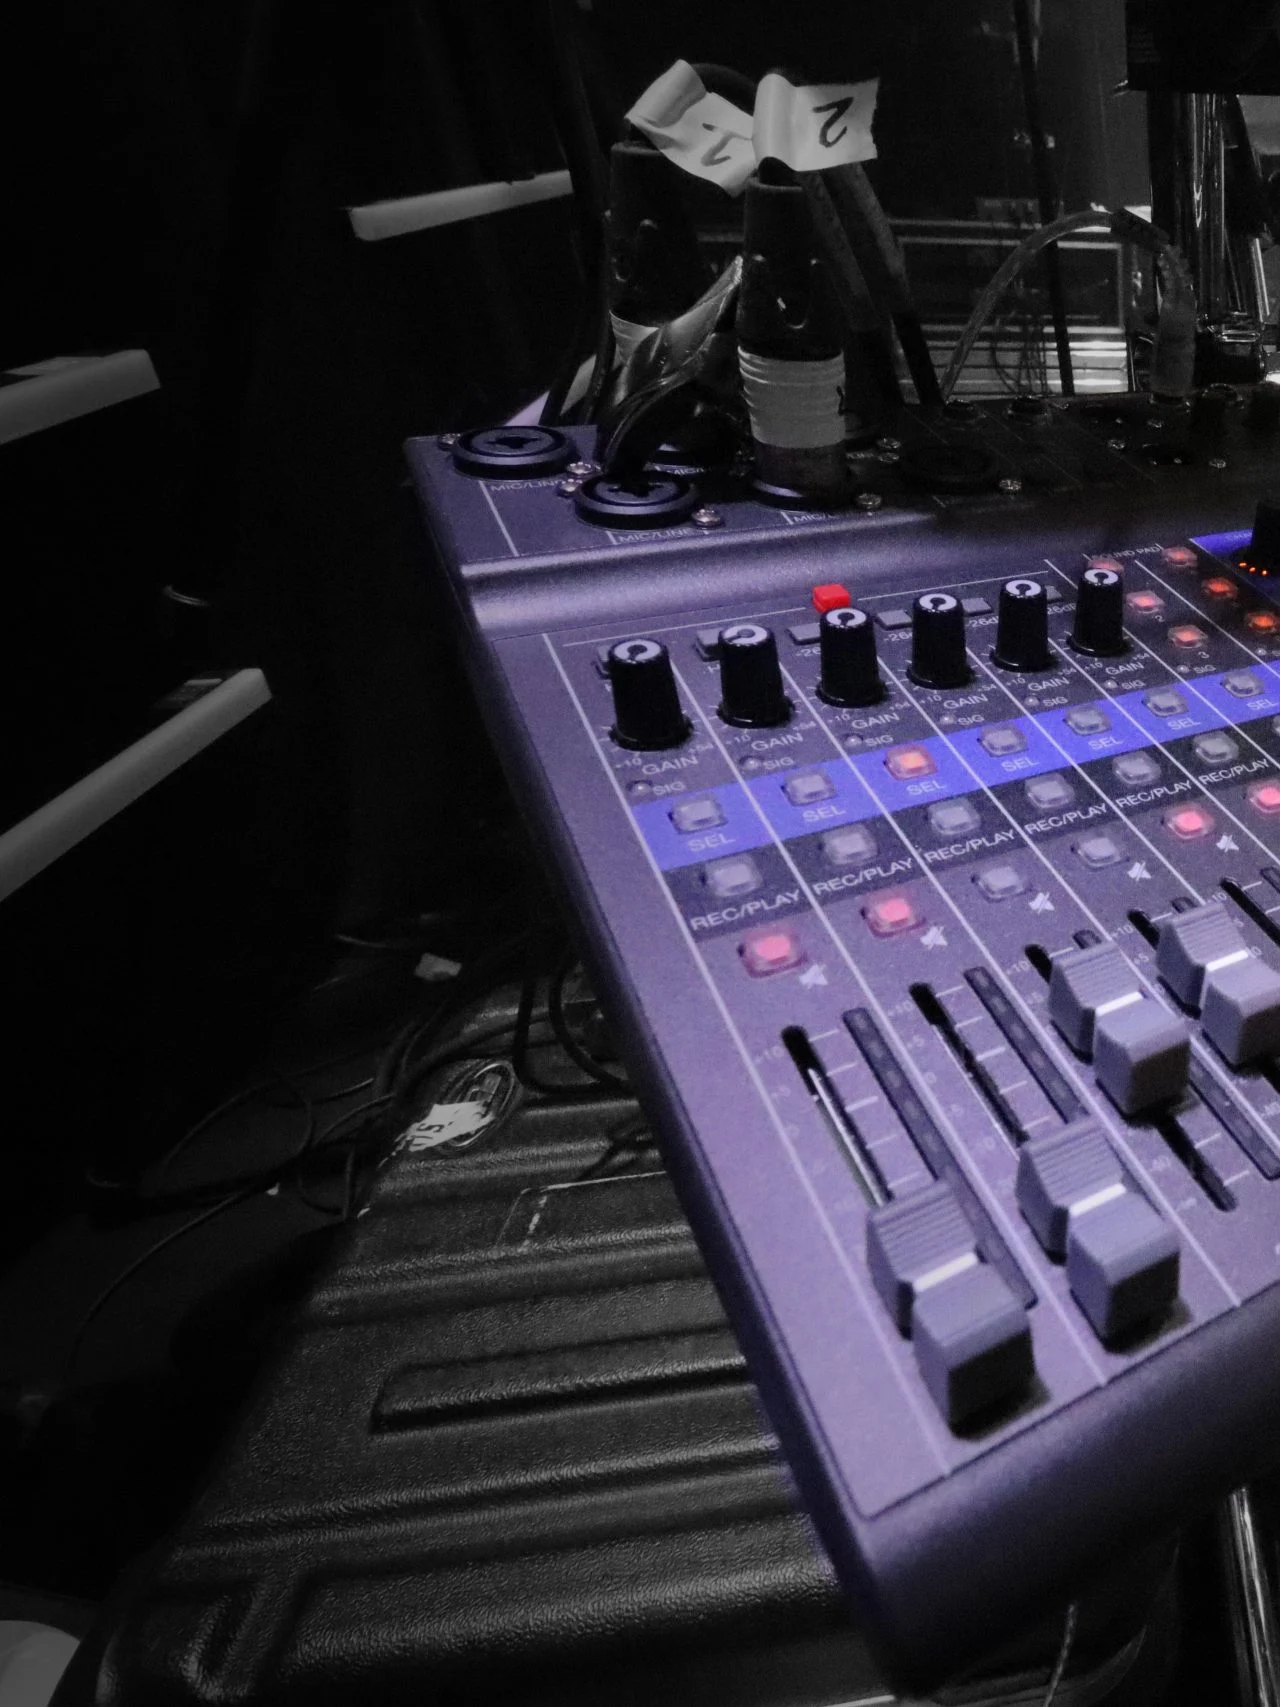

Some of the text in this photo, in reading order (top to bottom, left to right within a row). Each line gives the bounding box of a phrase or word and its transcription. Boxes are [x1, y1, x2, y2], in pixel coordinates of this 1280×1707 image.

[1105, 661, 1145, 676] GAIN
[1193, 664, 1217, 674] SIG
[1027, 676, 1070, 692] GAIN
[1121, 680, 1146, 691] SIG
[943, 693, 989, 709] GAIN
[1042, 696, 1069, 707] SIG
[1246, 698, 1279, 712] SEL
[851, 712, 900, 729] GAIN
[957, 714, 985, 726] SIG
[1167, 717, 1201, 731] SEL
[751, 733, 804, 751] GAIN
[865, 735, 894, 746] SIG
[1088, 735, 1124, 750] SEL
[641, 756, 698, 775] GAIN
[762, 757, 795, 770] SIG
[1001, 756, 1040, 773] SEL
[1198, 758, 1270, 786] REC/PLAY
[652, 781, 686, 796] SIG
[906, 779, 948, 796] SEL
[1115, 779, 1194, 809] REC/PLAY
[802, 805, 847, 822] SEL
[1024, 803, 1109, 835] REC/PLAY
[687, 834, 736, 851] SEL
[923, 829, 1017, 864] REC/PLAY
[812, 857, 914, 896] REC/PLAY
[689, 889, 803, 931] REC/PLAY
